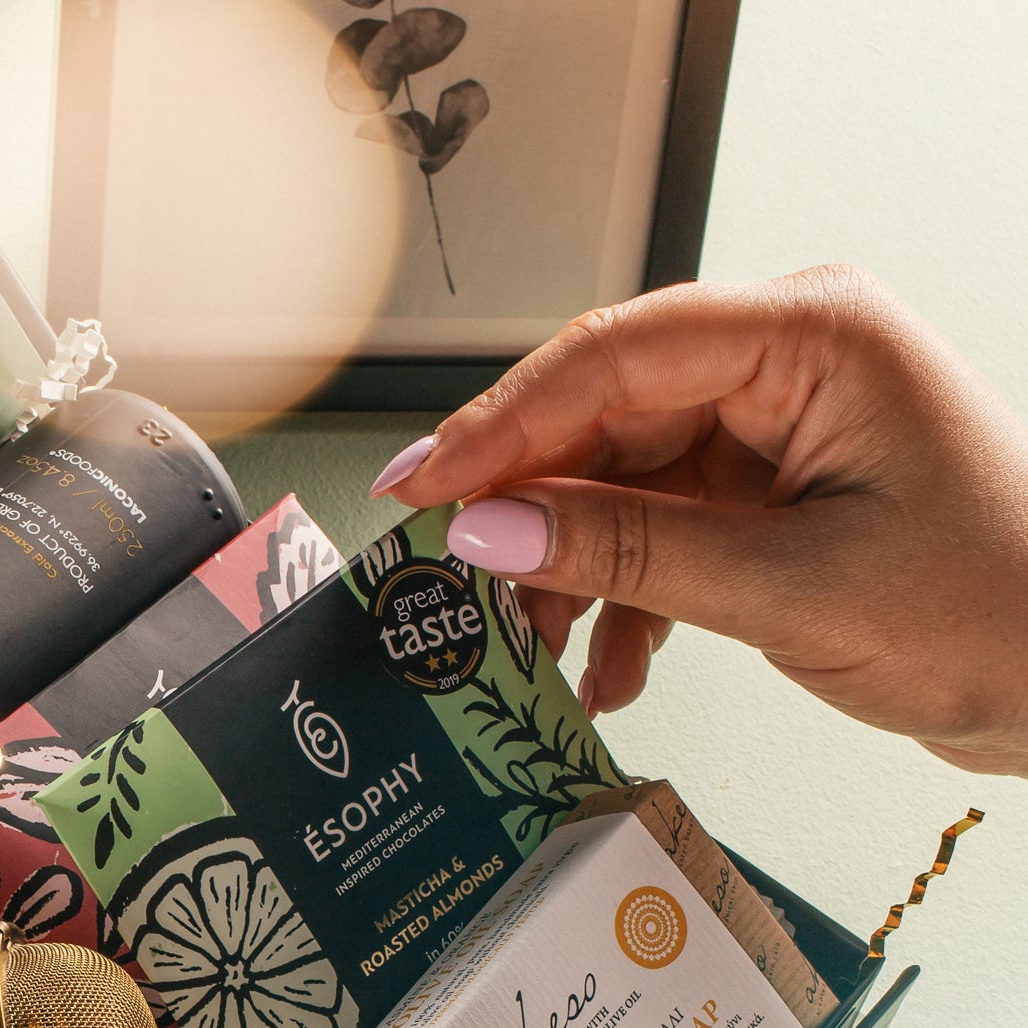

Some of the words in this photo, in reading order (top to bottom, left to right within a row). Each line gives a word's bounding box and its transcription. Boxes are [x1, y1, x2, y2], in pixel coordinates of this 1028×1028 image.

[16, 455, 76, 487] 8.45oz
[18, 519, 41, 535] OF
[89, 500, 144, 559] 250ml
[31, 552, 57, 578] Cold
[38, 534, 94, 594] PRODUCT
[393, 581, 449, 622] great
[379, 603, 483, 660] taste
[437, 673, 460, 690] 2019
[303, 752, 423, 862] ÉSOPHY
[341, 801, 424, 871] MEDITERRANEAN
[335, 856, 381, 896] INSPIRED
[382, 804, 446, 859] CHOCOLATES
[360, 915, 429, 977] ROASTED
[432, 854, 504, 922] ALMONDS
[374, 868, 452, 934] MASTICHA
[451, 856, 466, 873] &
[624, 990, 642, 1009] OIL
